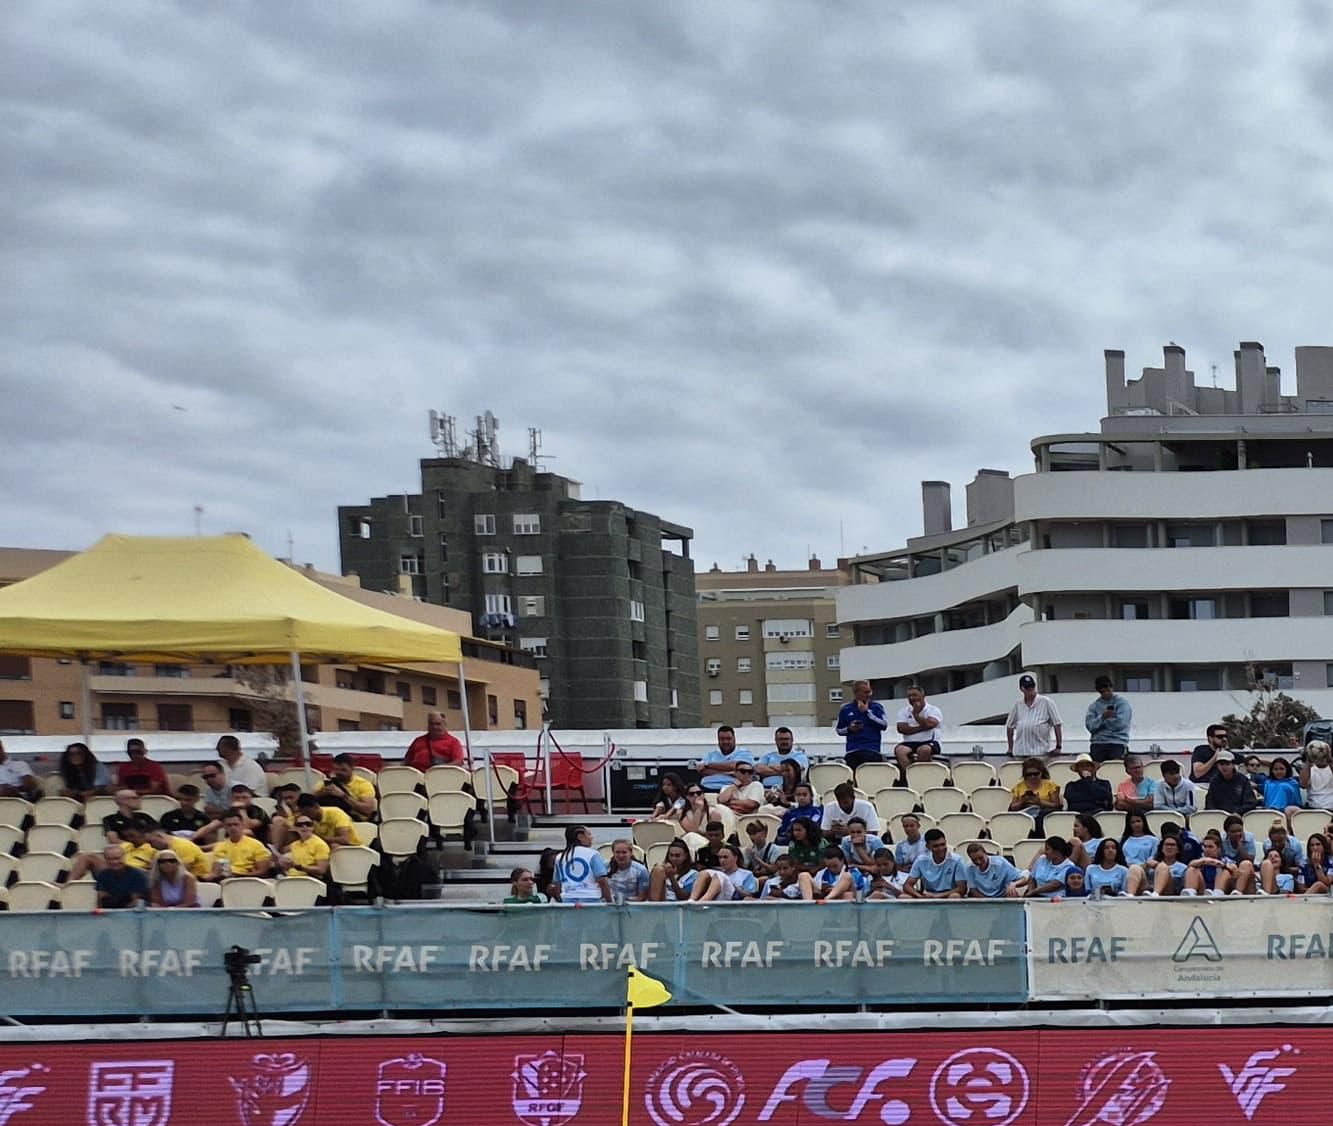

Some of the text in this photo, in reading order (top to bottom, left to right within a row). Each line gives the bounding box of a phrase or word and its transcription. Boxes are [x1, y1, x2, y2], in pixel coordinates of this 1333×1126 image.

[9, 948, 314, 978] RFAF RFAF FAF
[353, 942, 658, 972] RFAF RFAF RFAF
[702, 939, 1005, 968] RFAF RFAF RFAF
[1048, 936, 1128, 964] RFAF
